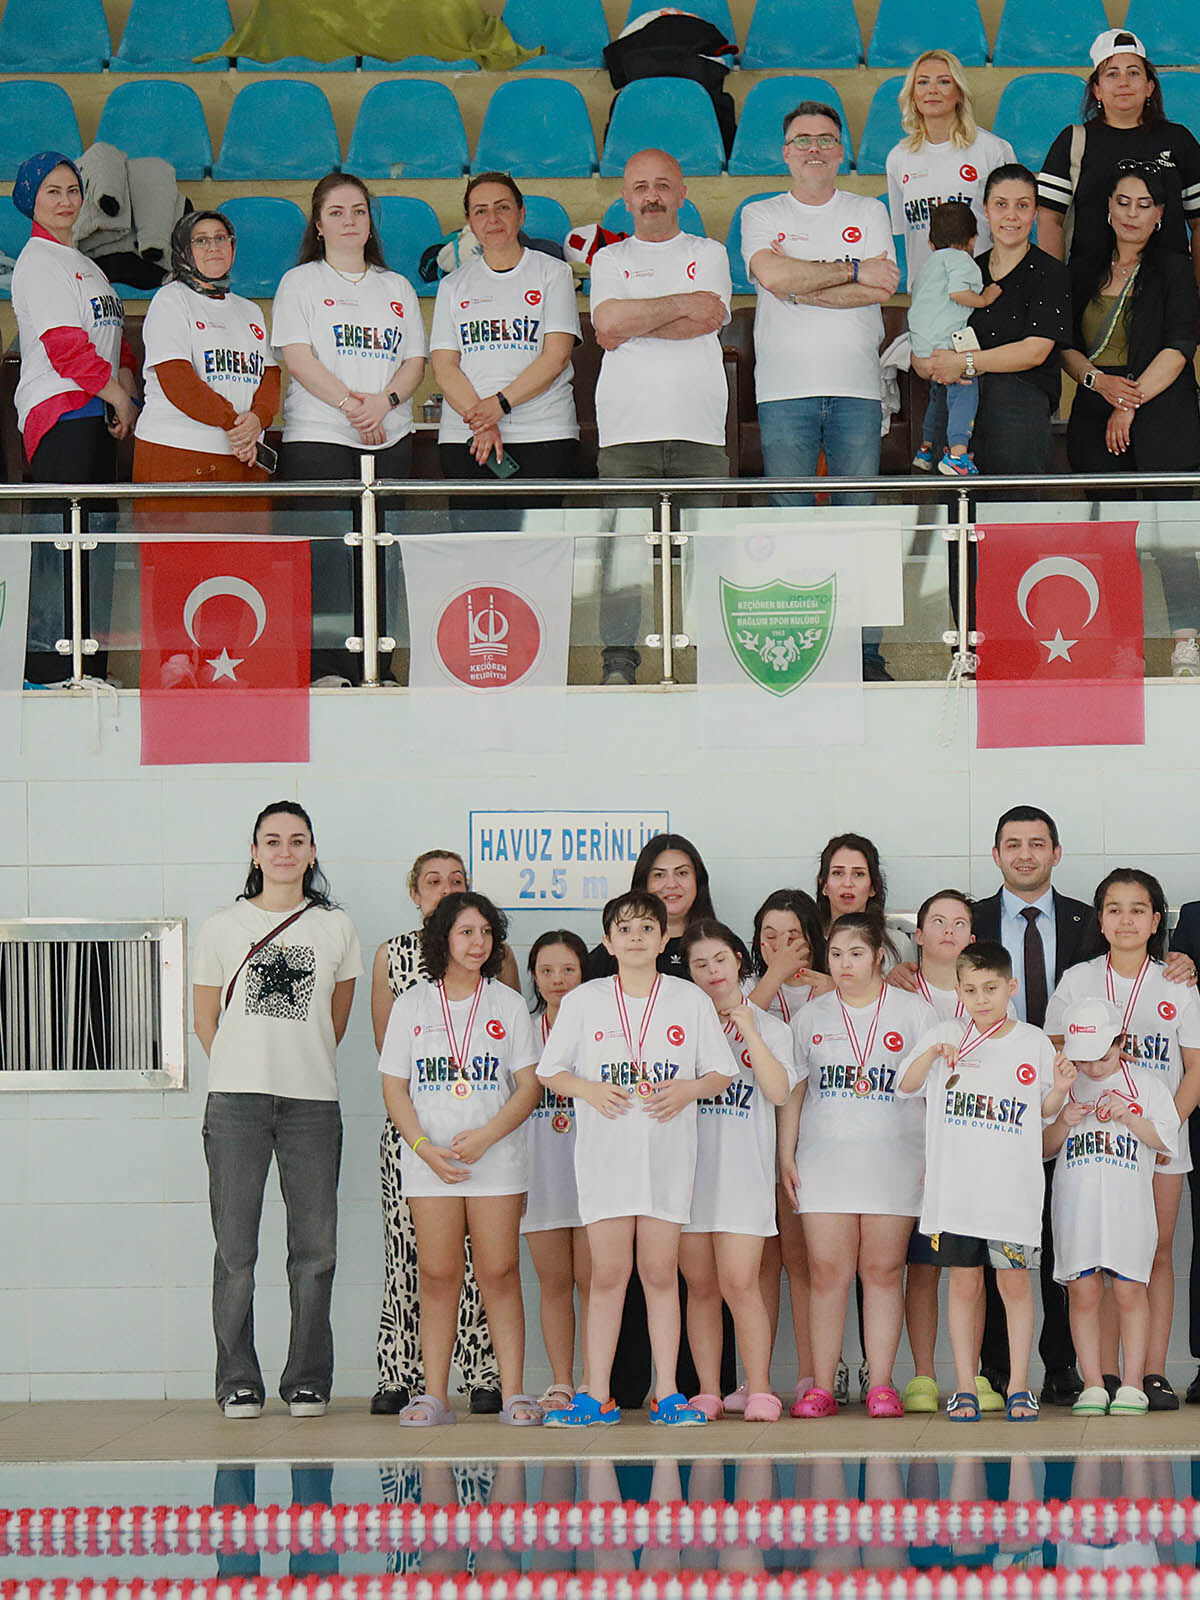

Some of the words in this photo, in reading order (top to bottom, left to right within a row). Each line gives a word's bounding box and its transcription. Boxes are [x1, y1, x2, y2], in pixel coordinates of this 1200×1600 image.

[460, 316, 540, 347] ENGELSİZ
[481, 828, 552, 862] HAVUZ
[519, 868, 567, 900] 2.5
[583, 874, 609, 900] m
[945, 1090, 1028, 1128] ENGELSİZ
[1066, 1130, 1139, 1162] ENGELSİZ
